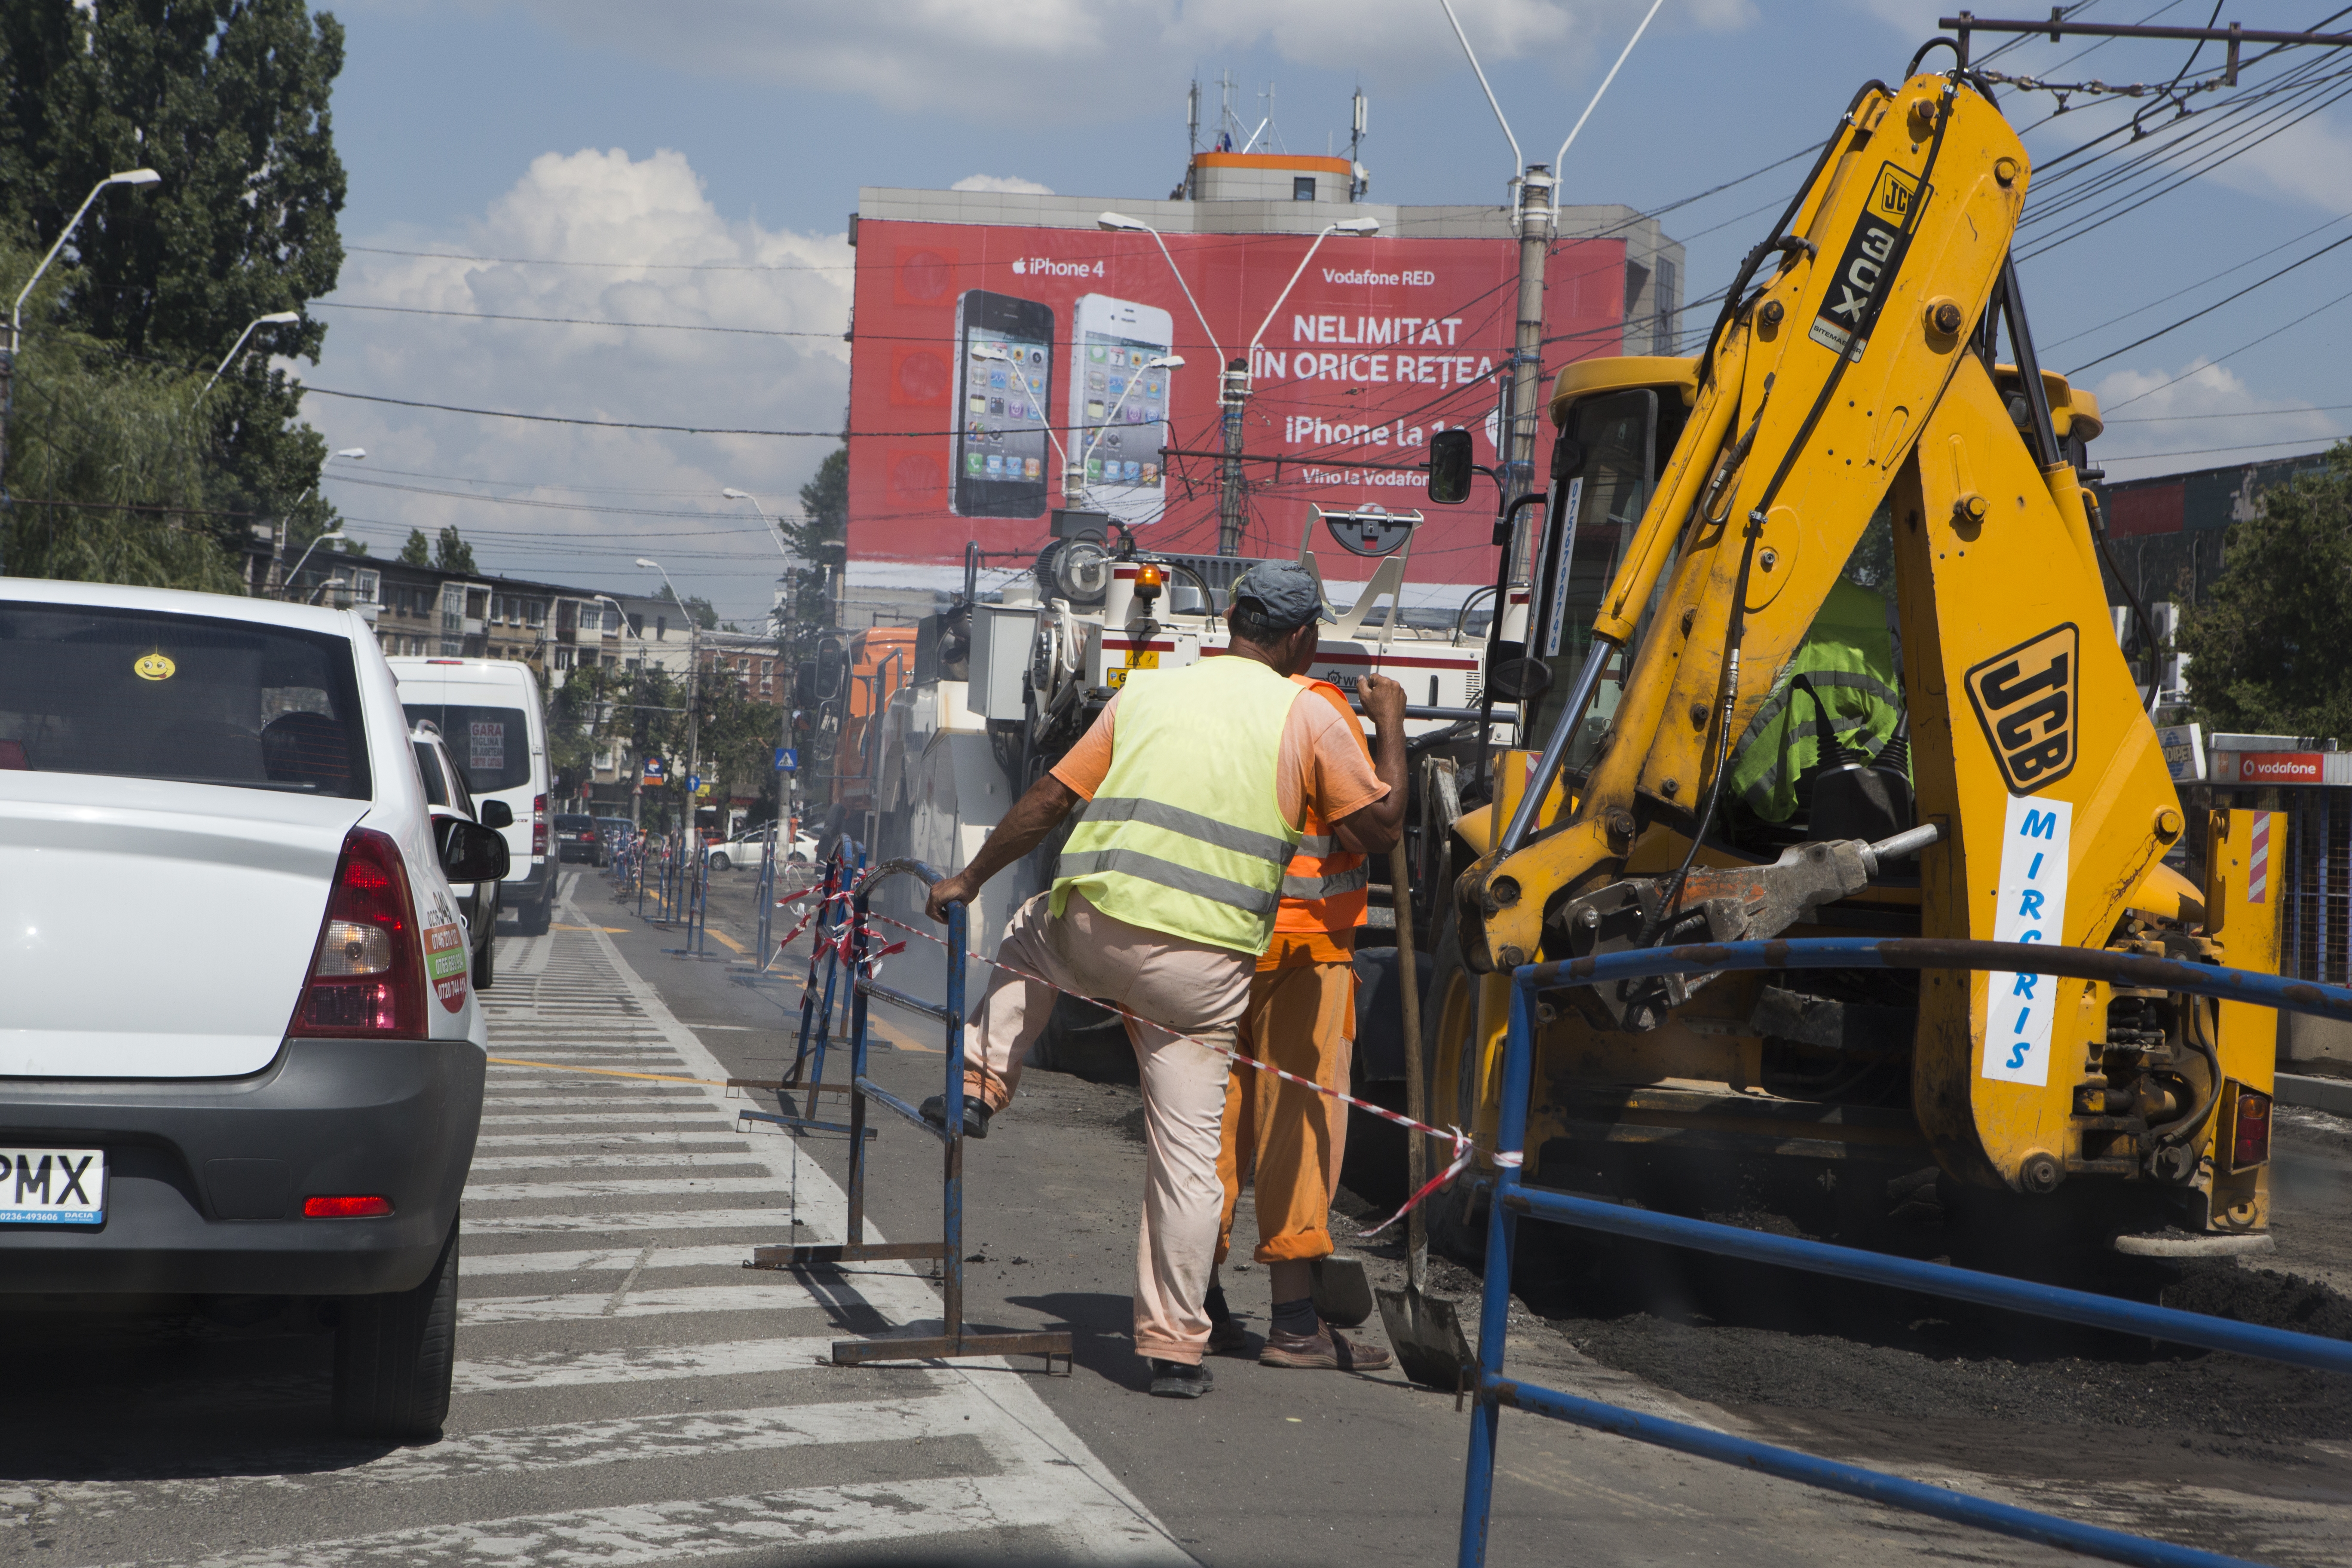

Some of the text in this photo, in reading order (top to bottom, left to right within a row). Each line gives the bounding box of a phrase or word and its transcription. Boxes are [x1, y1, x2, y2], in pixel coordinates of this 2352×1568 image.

[1030, 257, 1105, 278] iPhone 4
[1322, 268, 1435, 285] Vodafone RED
[1293, 314, 1462, 345] NELIMITAT
[1813, 325, 1862, 355] SITEMASER
[1254, 343, 1286, 379] ÎN
[1294, 352, 1389, 382] ORICE
[1286, 416, 1422, 447] iPhone la
[1303, 468, 1430, 487] Vino la Vodafon
[1550, 482, 1579, 652] 0756799744
[1343, 676, 1358, 686] Wi
[1980, 652, 2068, 781] JCB
[472, 724, 502, 736] GARA
[2258, 762, 2316, 774] vodafone
[427, 891, 452, 928] 0236 949
[432, 932, 444, 950] 0746
[435, 957, 448, 976] 0765
[438, 982, 451, 1001] 0720
[450, 979, 459, 996] 744
[0, 1212, 58, 1221] 0236-493606
